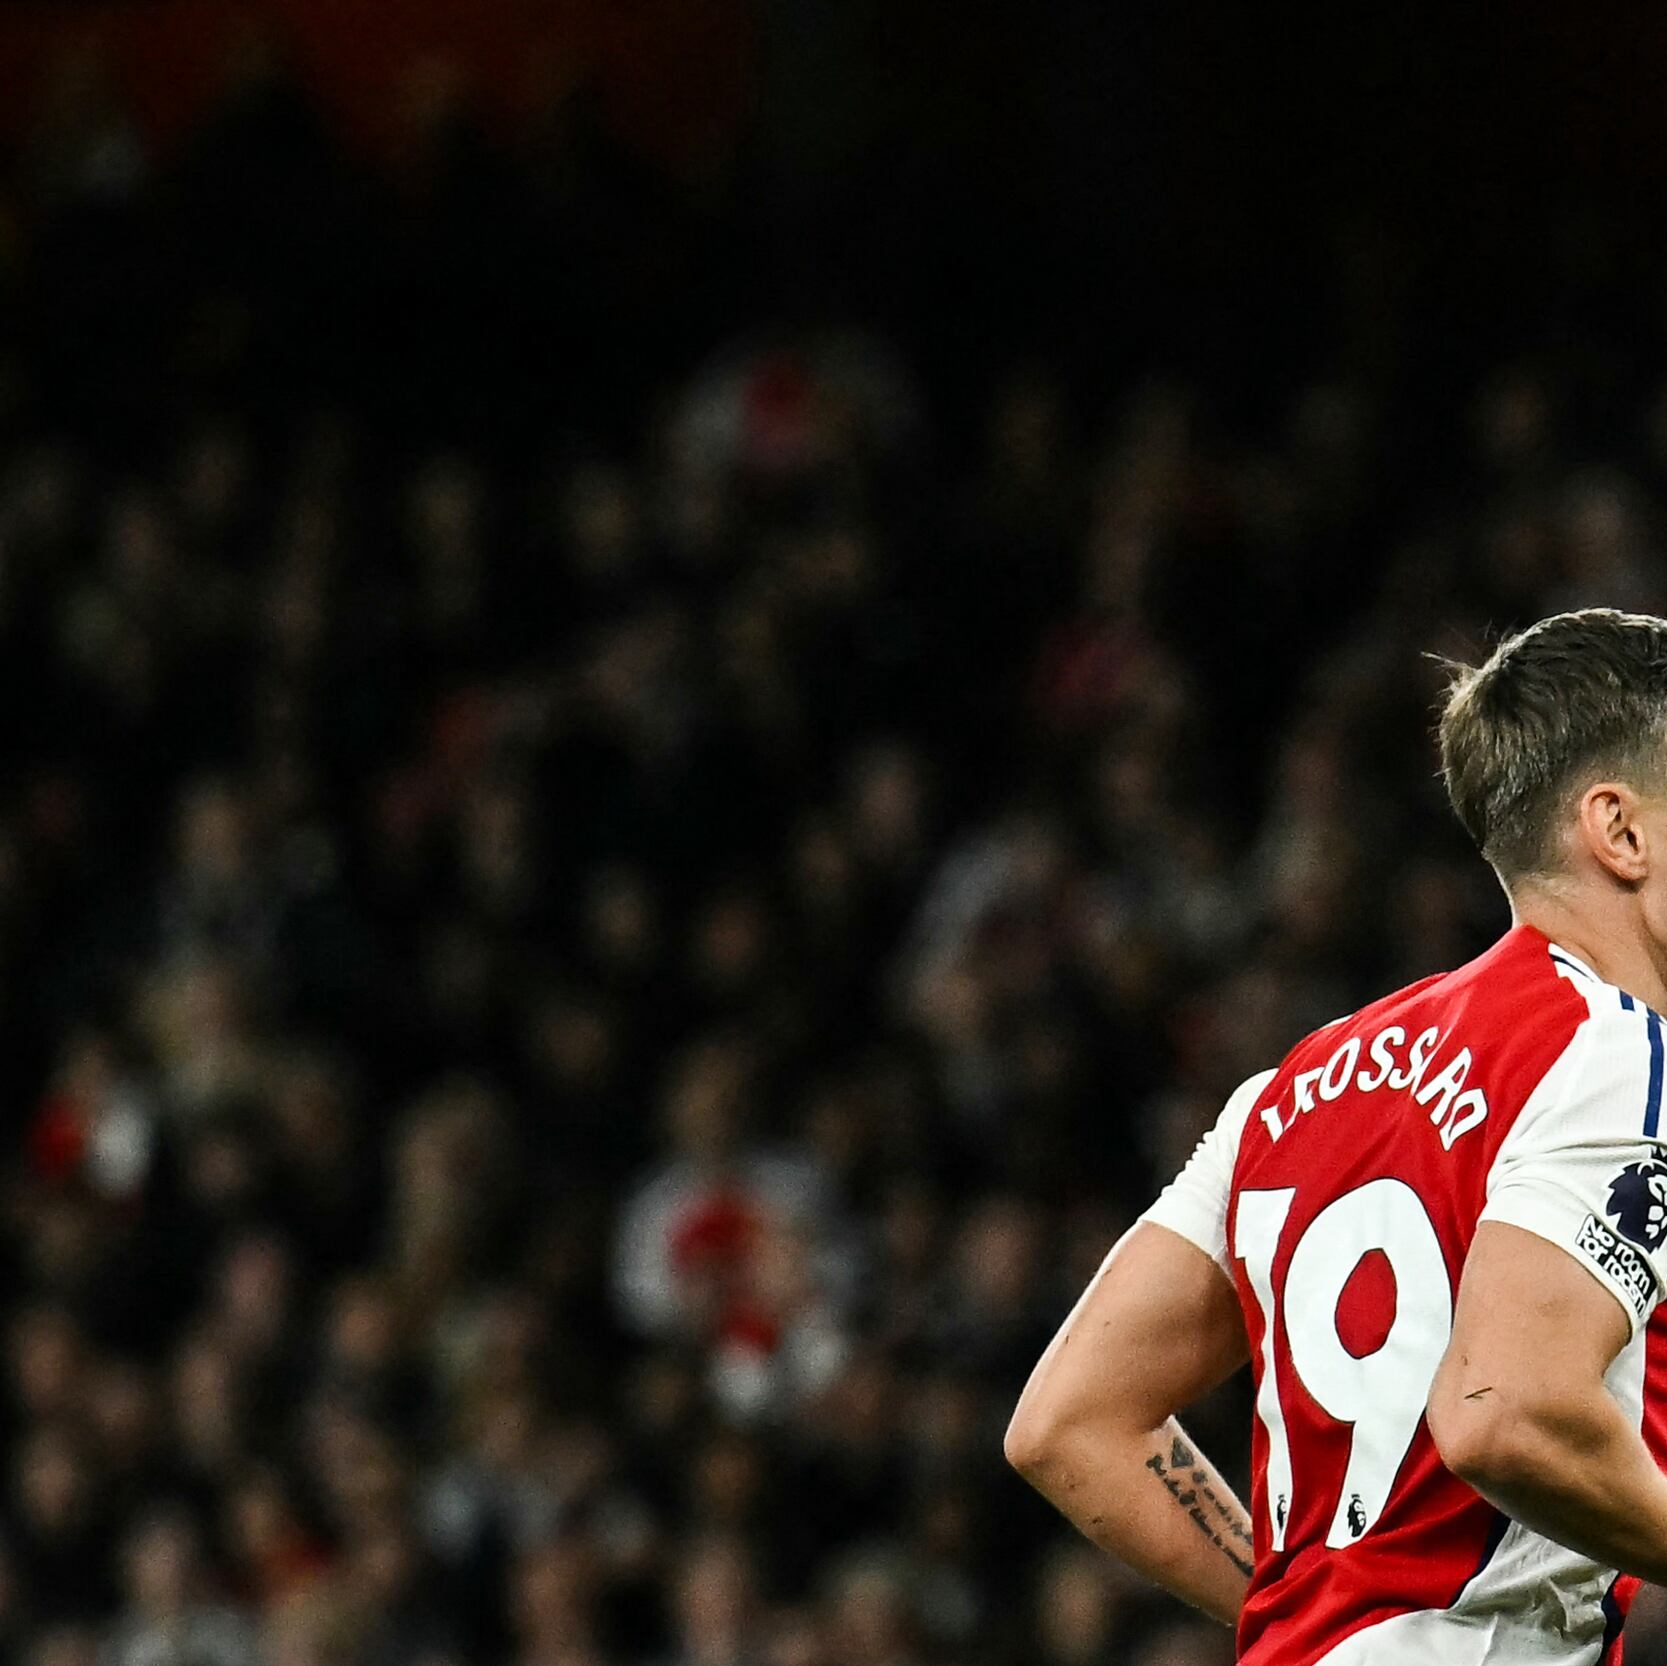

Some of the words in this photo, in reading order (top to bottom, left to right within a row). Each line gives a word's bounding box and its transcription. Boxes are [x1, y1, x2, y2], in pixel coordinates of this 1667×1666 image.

[1259, 1025, 1489, 1152] TROSSRD
[1581, 1213, 1616, 1248] No
[1614, 1242, 1651, 1295] room
[1603, 1254, 1648, 1318] racism
[1234, 1176, 1454, 1553] 19
